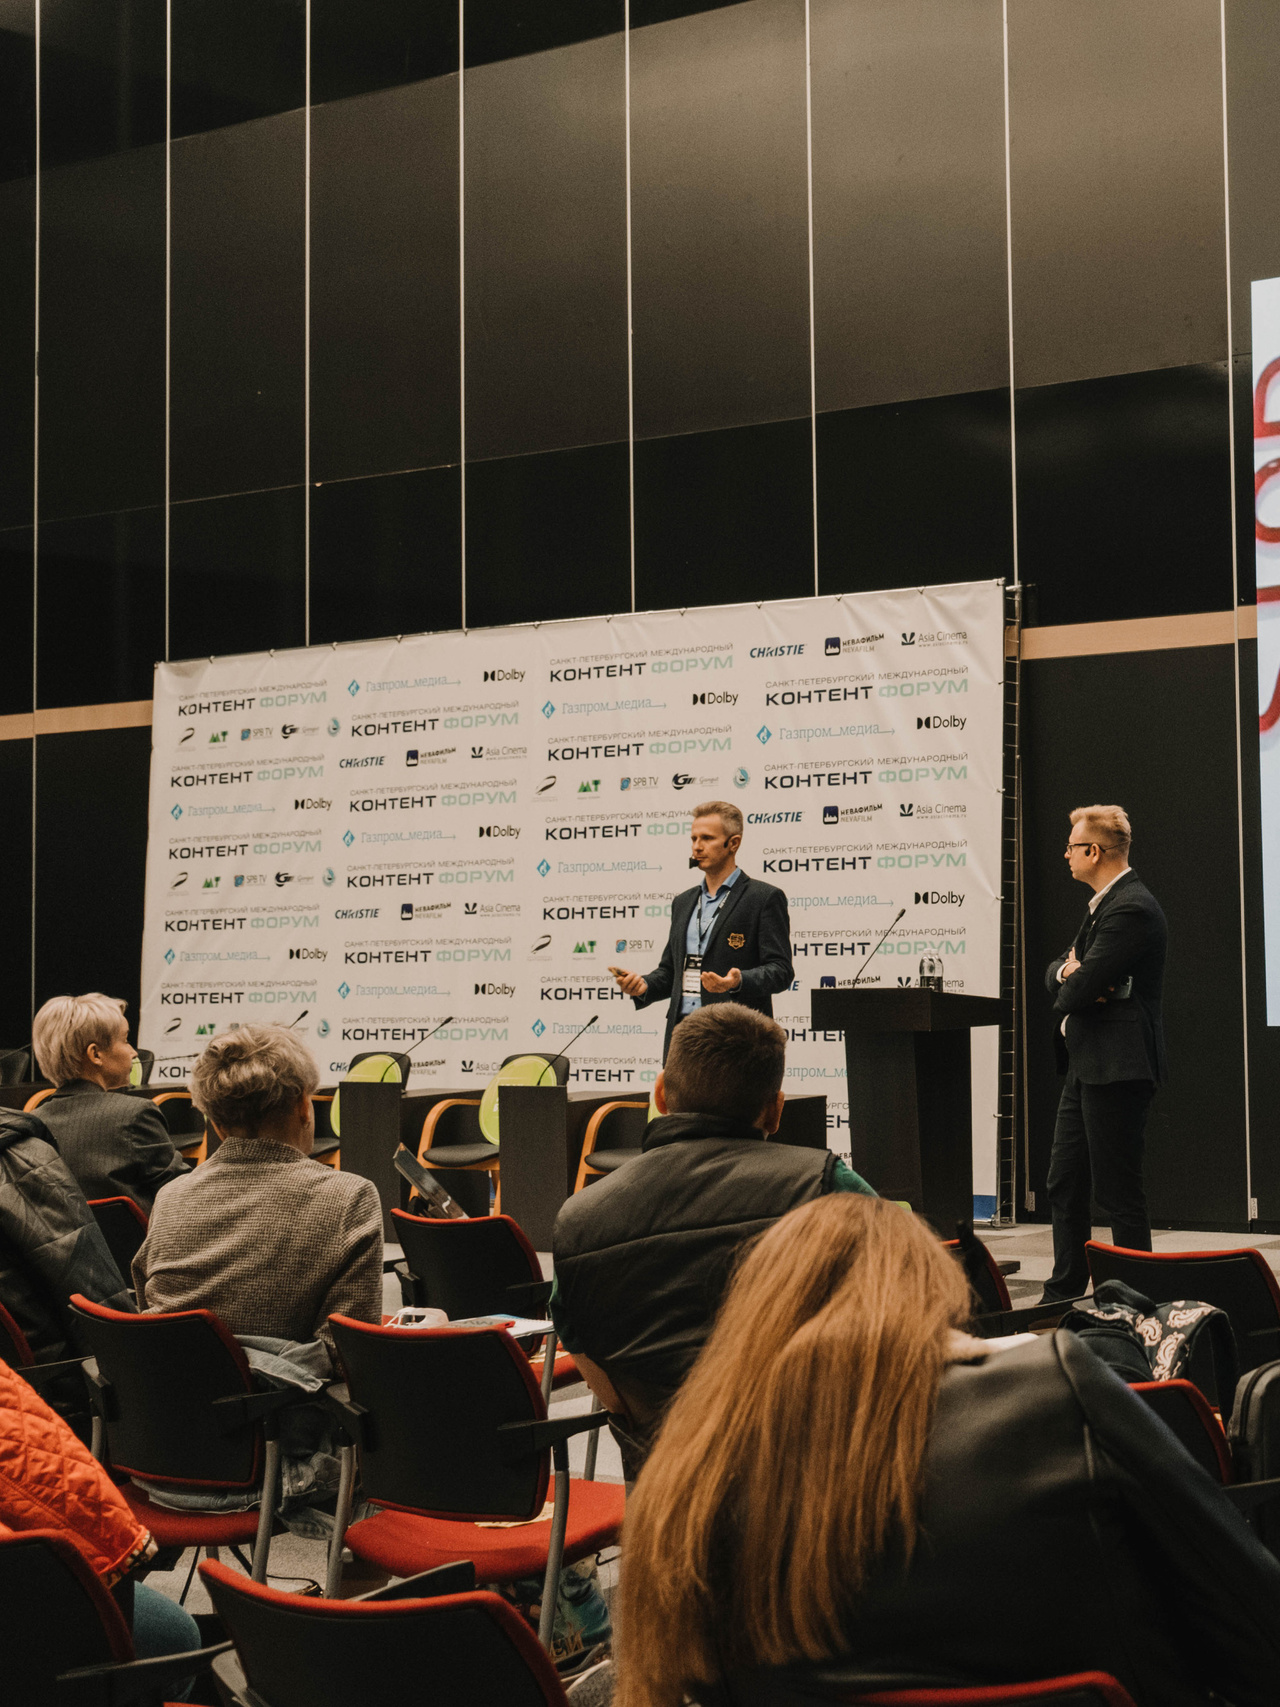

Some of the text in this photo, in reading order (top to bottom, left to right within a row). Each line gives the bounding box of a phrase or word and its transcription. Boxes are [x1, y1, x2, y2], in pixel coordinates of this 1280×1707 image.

[843, 633, 884, 647] НЕВАФИЛЬМ
[918, 631, 967, 642] Asia Cinema
[550, 643, 733, 665] САНКТ-ПЕТЕРБУРГСКИЙ МЕЖДУНАРОДНЫЙ
[497, 669, 525, 682] Dolby
[551, 655, 733, 682] КОНТЕНТ ФОРУМ
[766, 666, 968, 688] САНКТ-ПЕТЕРБУРГСКИЙ МЕЖДУНАРОДНЫЙ
[708, 692, 738, 707] Dolby
[766, 679, 968, 706] КОНТЕНТ ФОРУМ
[179, 691, 327, 716] КОНТЕНТ ФОРУМ
[352, 700, 519, 721] САНКТ-ПЕТЕРБУРГСКИЙ МЕЖДУНАРОДНЫЙ
[352, 713, 518, 737] КОНТЕНТ ФОРУМ
[933, 716, 967, 731] Dolby
[265, 728, 273, 736] TV
[548, 726, 732, 744] САНКТ-ПЕТЕРБУРГСКИЙ МЕЖДУНАРОДНЫЙ
[486, 746, 527, 756] Asia Cinema
[548, 738, 732, 761] КОНТЕНТ ФОРУМ
[764, 753, 968, 772] САНКТ-ПЕТЕРБУРГСКИЙ МЕЖДУНАРОДНЫЙ
[171, 765, 323, 787] КОНТЕНТ ФОРУМ
[650, 777, 658, 786] TV
[765, 766, 967, 789] КОНТЕНТ ФОРУМ
[351, 778, 517, 796] САНКТ-ПЕТЕРБУРГСКИЙ МЕЖДУНАРОДНЫЙ
[306, 797, 332, 811] Dolby
[350, 796, 436, 812] КОНТЕНТ
[442, 791, 516, 806] ФОРУМ
[916, 803, 966, 814] Asia Cinema
[546, 809, 692, 823] САНКТ-ПЕТЕРБУРГСКИЙ МЕЖДУНА
[841, 804, 883, 815] НЕВАФИЛЬМ
[493, 826, 521, 839] Dolby
[546, 822, 692, 840] КОНТЕНТ ФОР
[169, 840, 322, 859] КОНТЕНТ ФОРУМ
[763, 840, 967, 855] САНКТ-ПЕТЕРБУРГСКИЙ МЕЖДУНАРОДНЫЙ
[347, 857, 514, 872] САНКТ-ПЕТЕРБУРГСКИЙ МЕЖДУНАРОДНЫЙ
[763, 853, 966, 873] КОНТЕНТ ФОРУМ
[258, 875, 267, 883] TV
[348, 870, 513, 887] КОНТЕНТ ФОРУМ
[543, 893, 641, 903] САНКТ-ПЕТЕРБУРГСКИЙ
[931, 892, 965, 907] Dolby
[480, 903, 520, 912] Asia Cinema
[543, 906, 639, 920] КОНТЕНТ
[165, 915, 319, 932] КОНТЕНТ ФОРУМ
[791, 927, 966, 938] -ПЕТЕРБУРГСКИЙ МЕЖДУНАРОДНЫЙ
[345, 937, 511, 947] САНКТ-ПЕТЕРБУРГСКИЙ МЕЖДУНАРОДНЫЙ
[644, 940, 654, 948] TV
[794, 941, 965, 956] НТЕНТ ФОРУМ
[302, 948, 328, 962] Dolby
[345, 950, 431, 964] КОНТЕНТ
[436, 949, 511, 962] ФОРУМ
[488, 983, 515, 997] Dolby
[541, 988, 623, 1000] КОНТЕН
[162, 991, 317, 1004] КОНТЕНТ ФОРУМ
[342, 1016, 430, 1024] САНКТ-ПЕТЕРБУРГСКИЙ
[342, 1028, 508, 1041] КОНТЕНТ ФОРУМ
[476, 1062, 489, 1070] Asia
[569, 1069, 634, 1082] НТЕНТ
